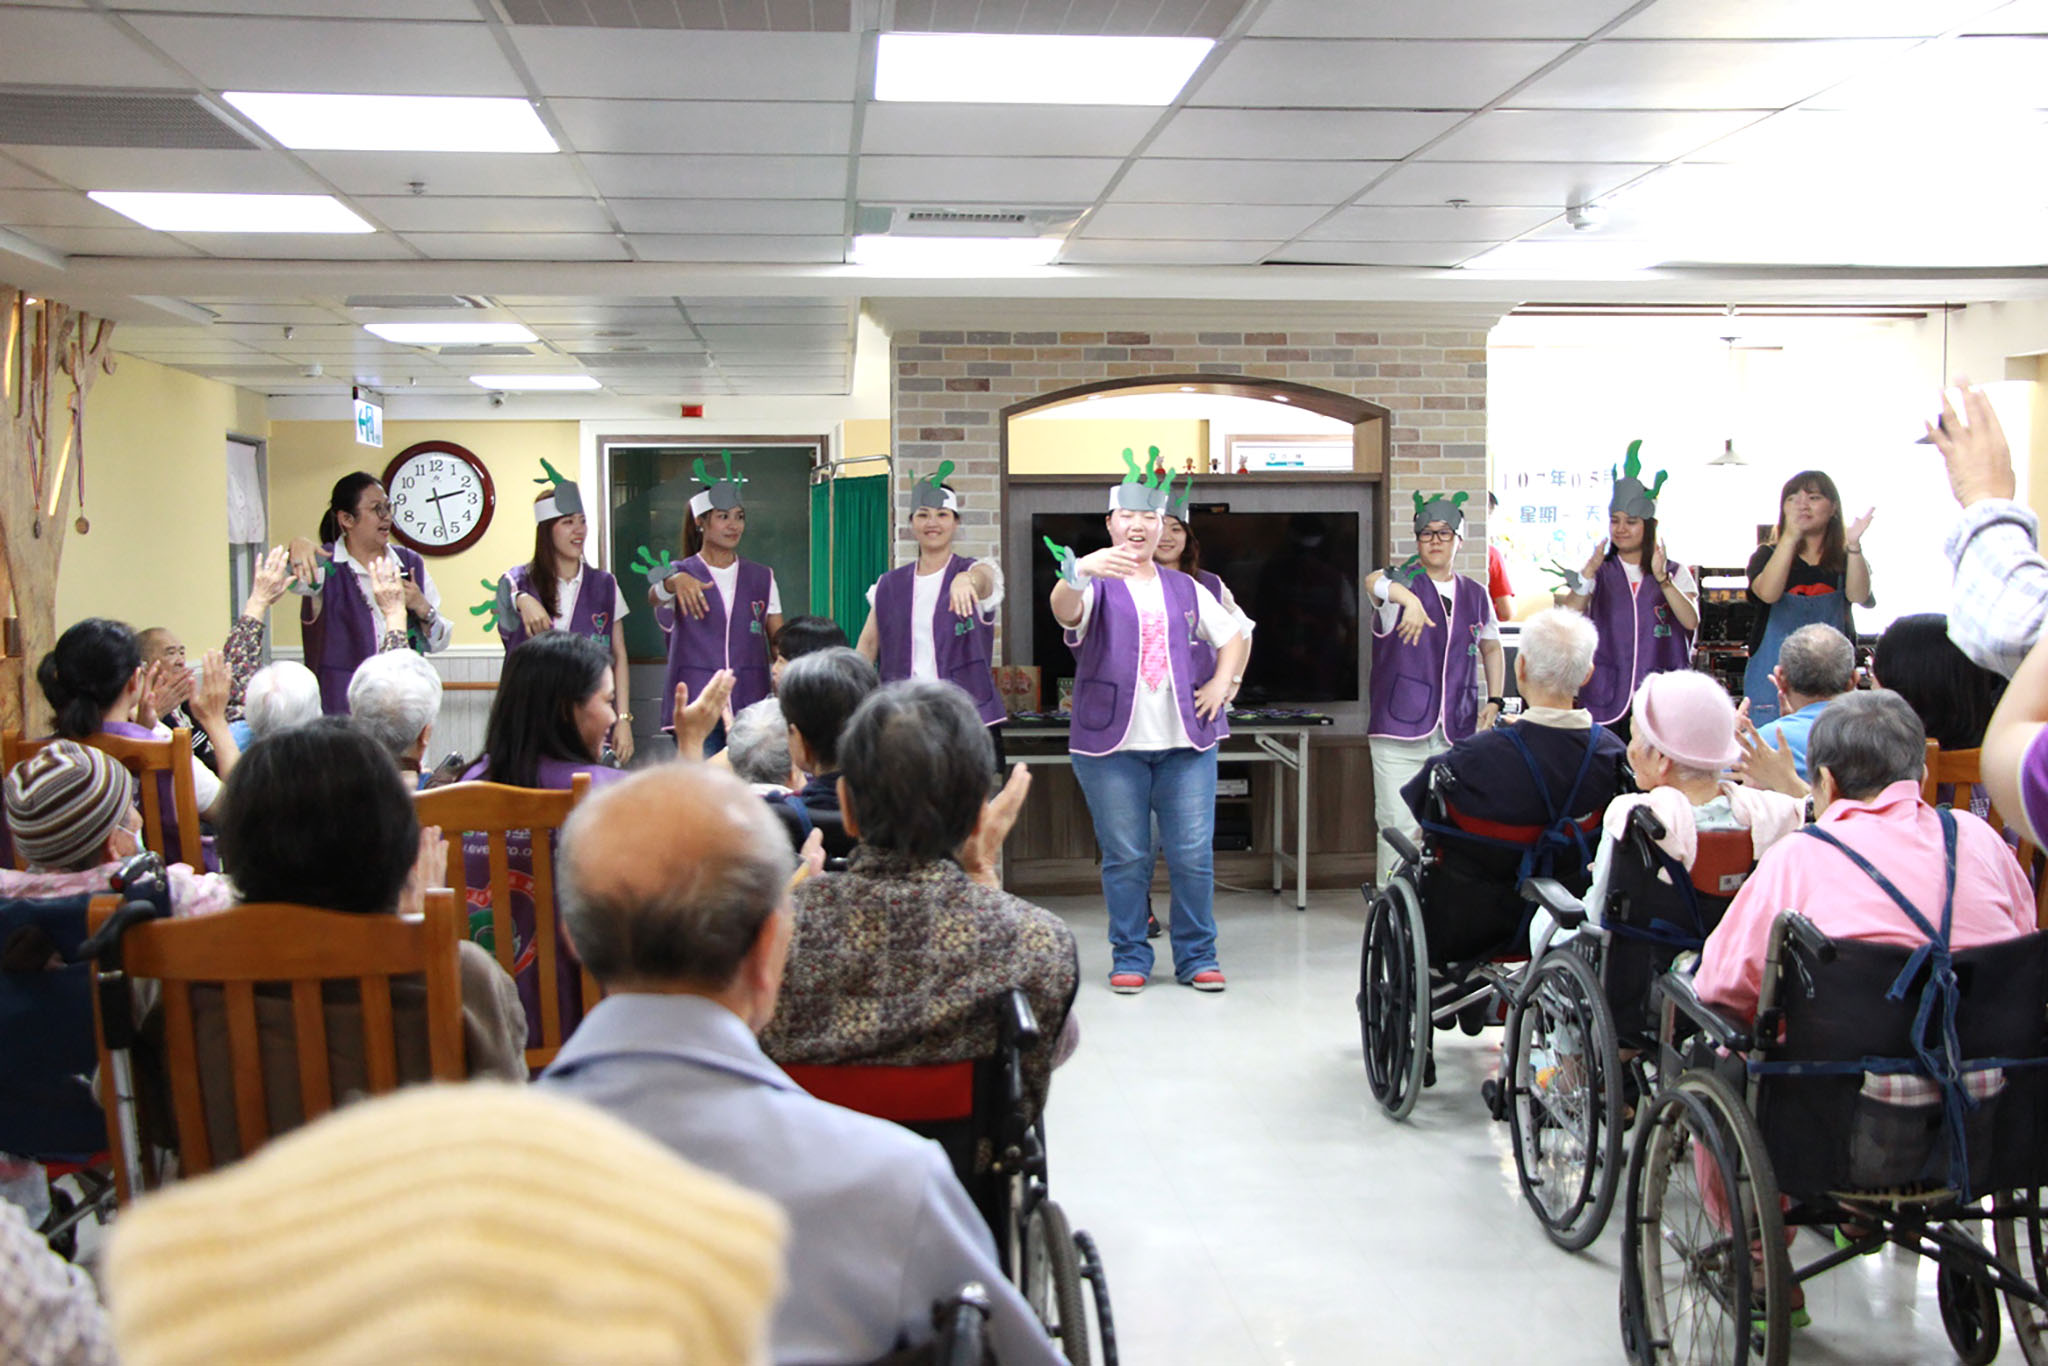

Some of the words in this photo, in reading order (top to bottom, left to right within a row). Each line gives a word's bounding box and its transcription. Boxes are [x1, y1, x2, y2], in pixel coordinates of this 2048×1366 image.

[415, 464, 425, 476] 11
[430, 459, 443, 472] 12
[451, 464, 456, 476] 1
[402, 476, 415, 489] 10
[461, 475, 471, 488] 2
[396, 493, 407, 505] 9
[467, 492, 478, 505] 3
[404, 510, 414, 522] 8
[462, 509, 471, 521] 4
[417, 522, 427, 534] 7
[433, 526, 443, 538] 6
[450, 521, 460, 534] 5
